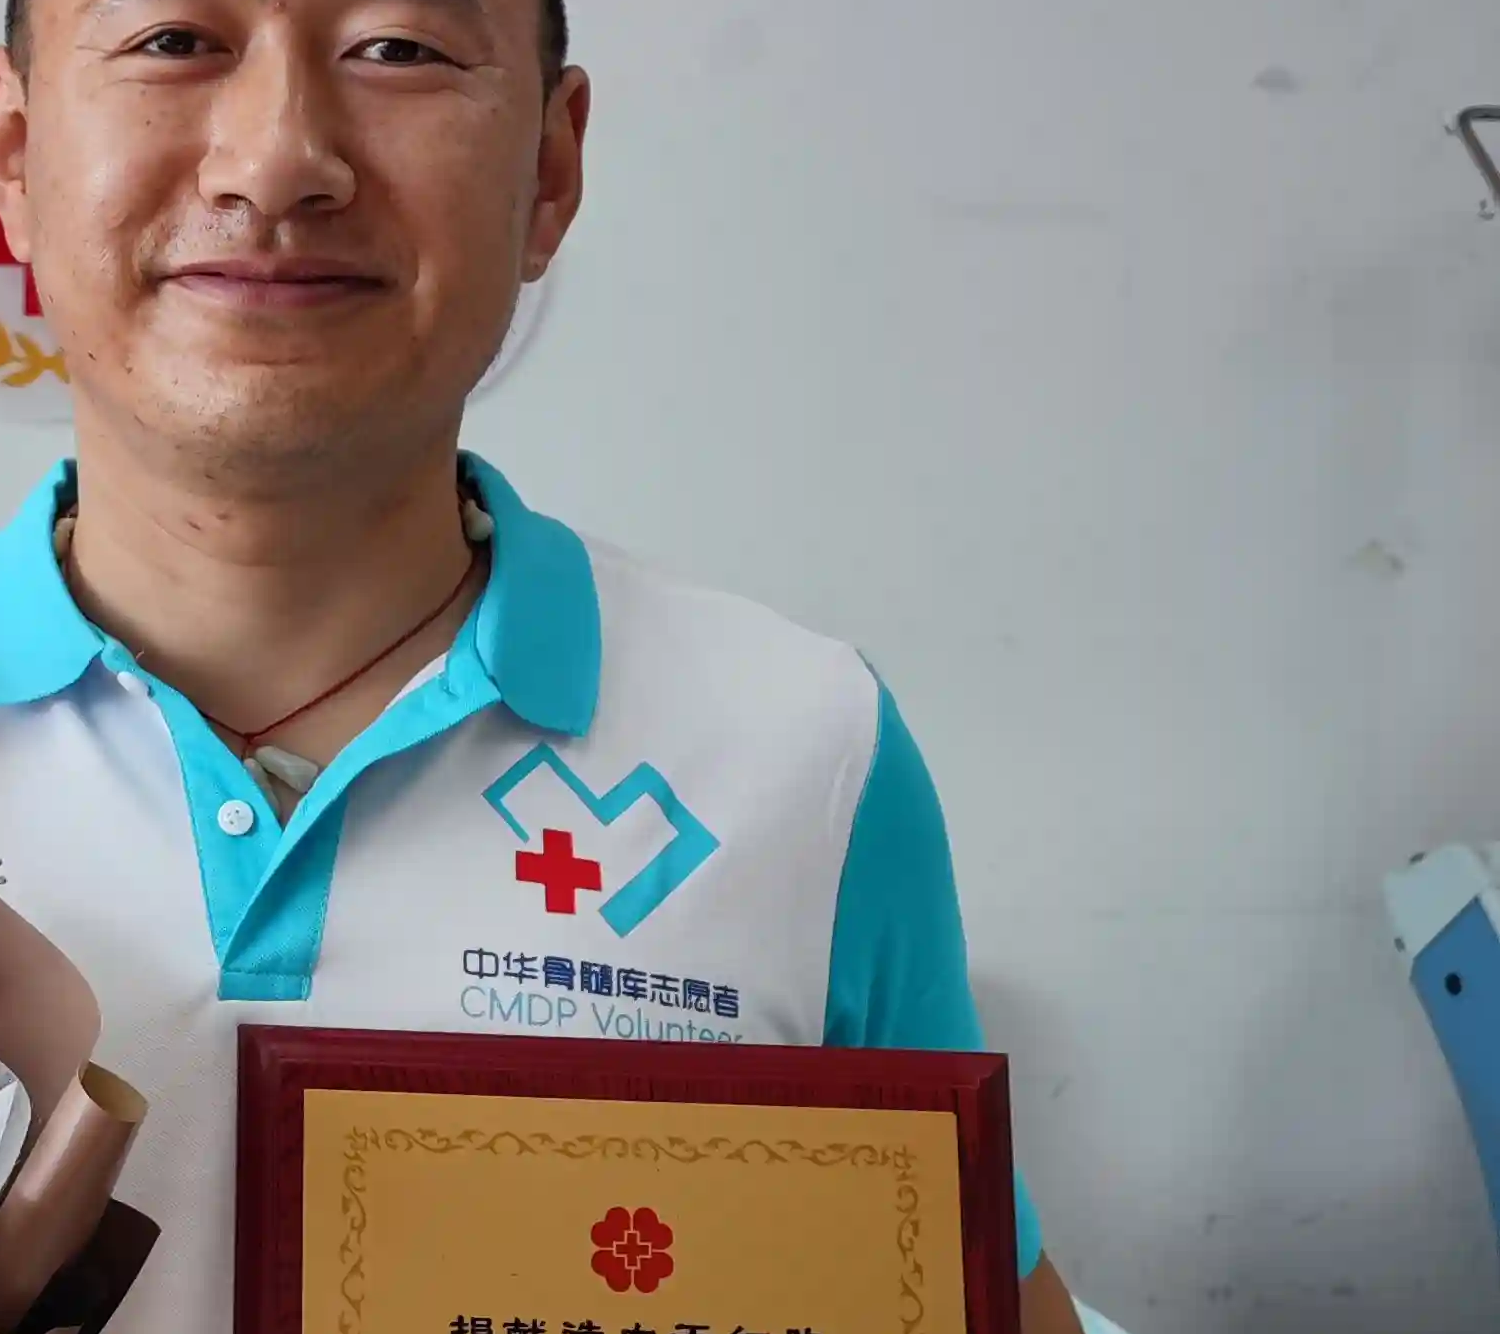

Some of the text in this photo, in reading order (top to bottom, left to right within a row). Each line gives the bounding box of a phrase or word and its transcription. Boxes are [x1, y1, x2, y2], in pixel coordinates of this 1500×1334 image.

[461, 986, 577, 1027] CMDP
[463, 948, 739, 1018] 中华骨髓库志愿者
